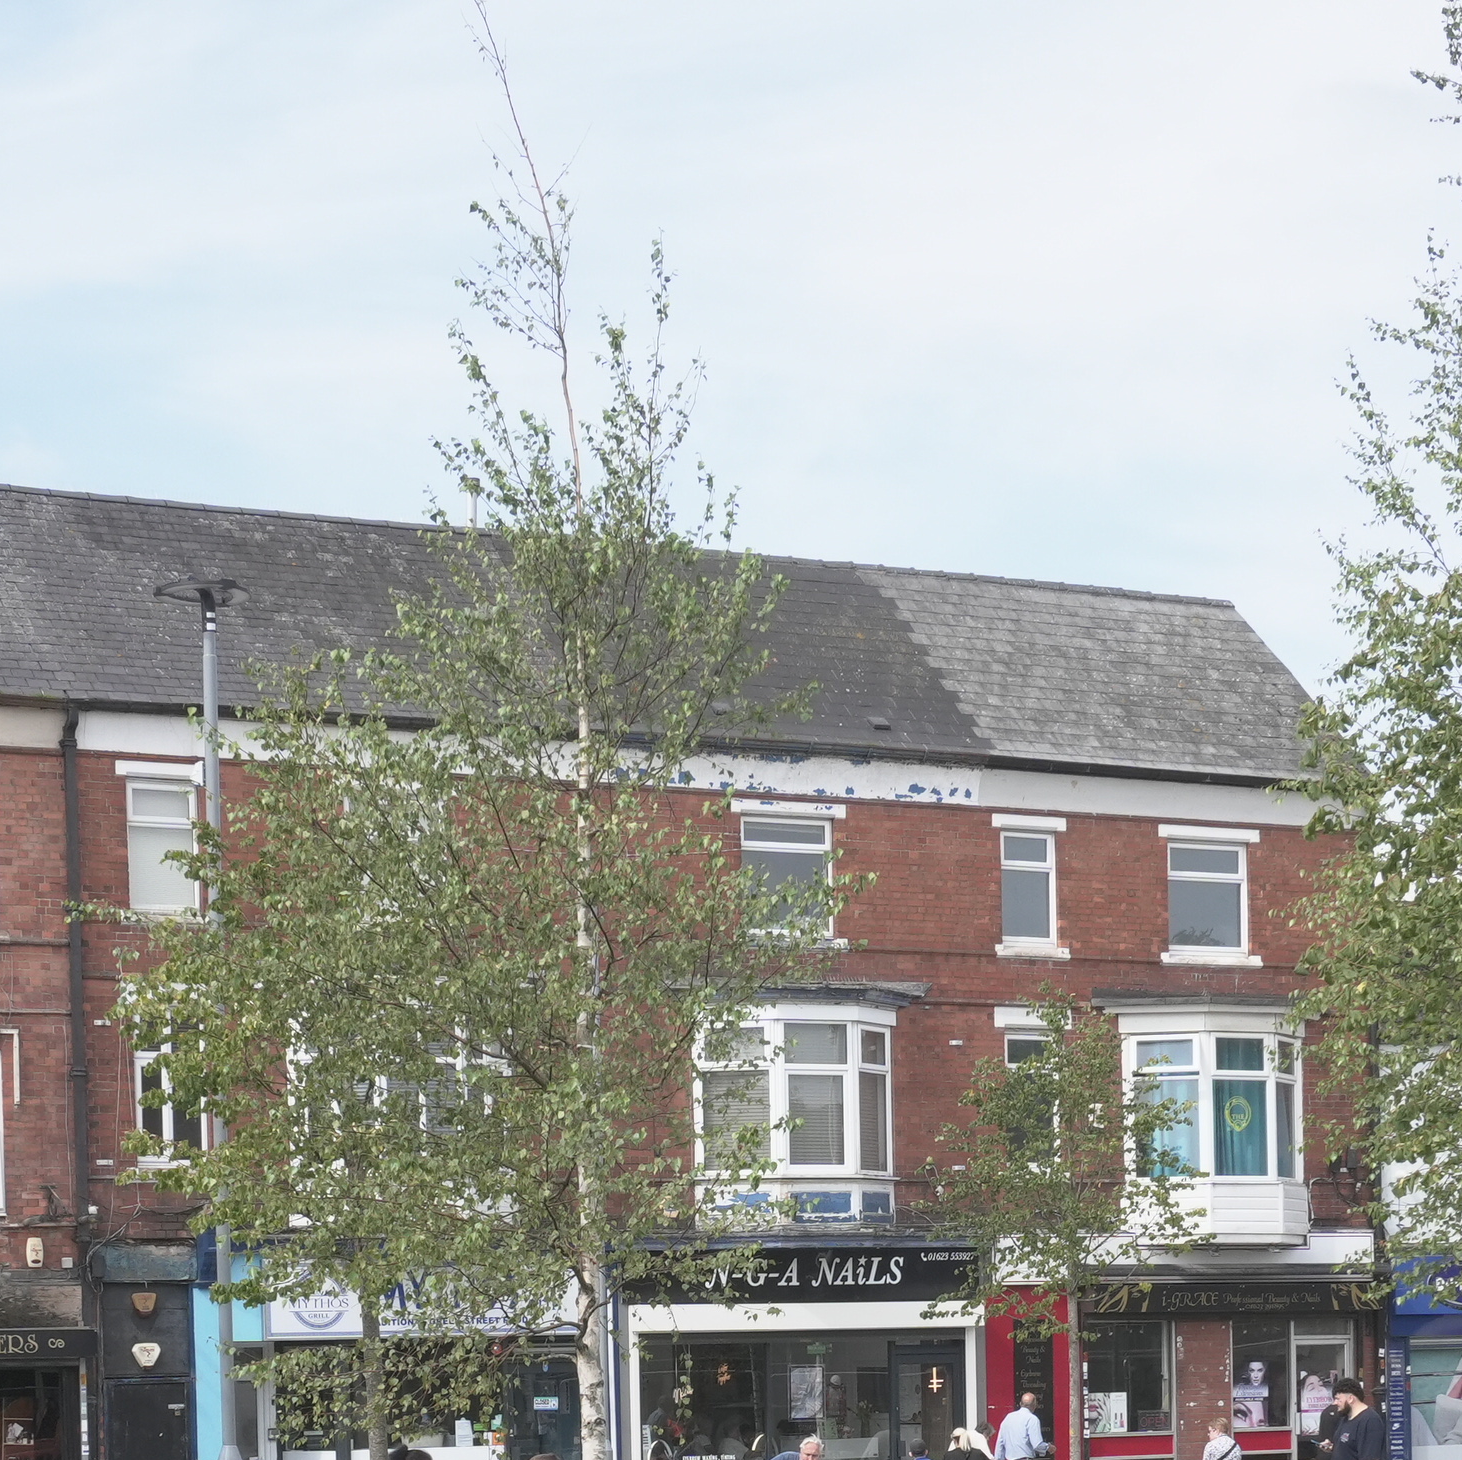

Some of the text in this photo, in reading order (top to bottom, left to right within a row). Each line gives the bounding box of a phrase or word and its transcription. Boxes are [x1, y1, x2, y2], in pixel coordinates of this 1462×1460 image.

[927, 1252, 949, 1261] 01623
[289, 1297, 349, 1309] MYTHOS
[464, 1316, 501, 1326] STREET
[1139, 1415, 1168, 1429] OPEN
